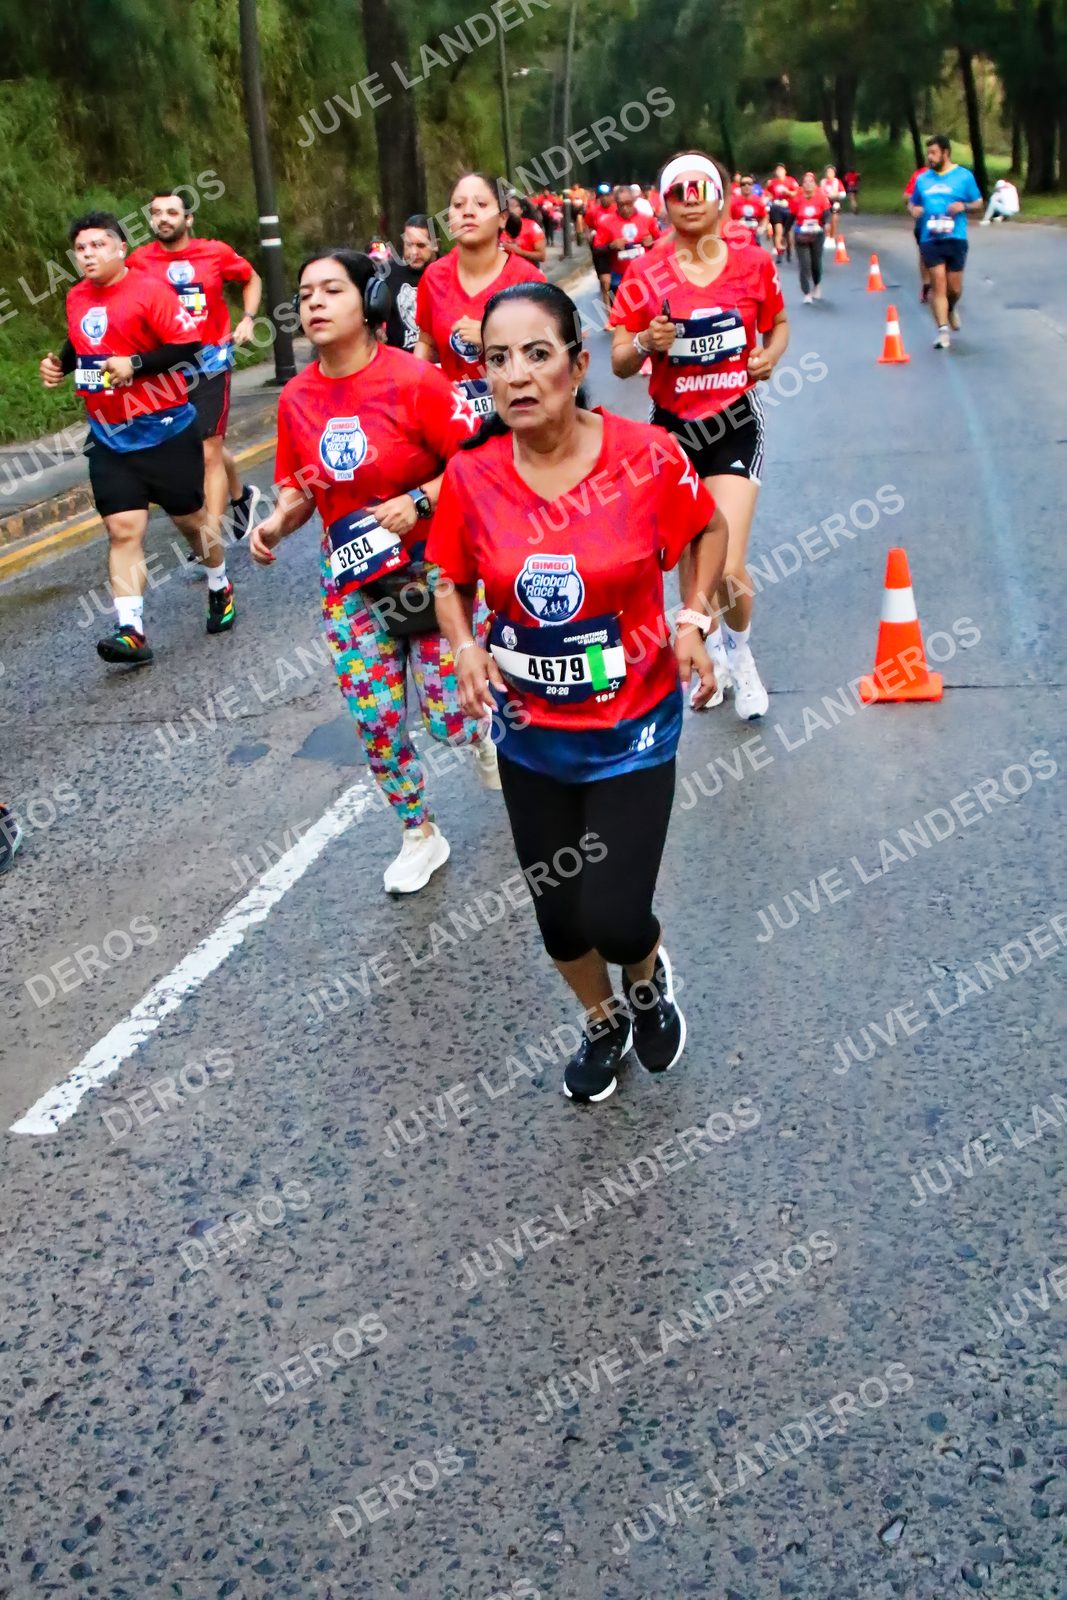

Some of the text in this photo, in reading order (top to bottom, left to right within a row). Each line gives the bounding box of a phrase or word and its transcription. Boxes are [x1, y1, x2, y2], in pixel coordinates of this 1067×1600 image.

[690, 334, 724, 354] 4922
[674, 370, 748, 394] SANTIAGO
[336, 535, 374, 569] 5264
[531, 561, 569, 571] BIMBO
[532, 574, 568, 588] Global
[525, 585, 555, 598] Race
[528, 656, 585, 682] 4679
[595, 692, 616, 703] 10K
